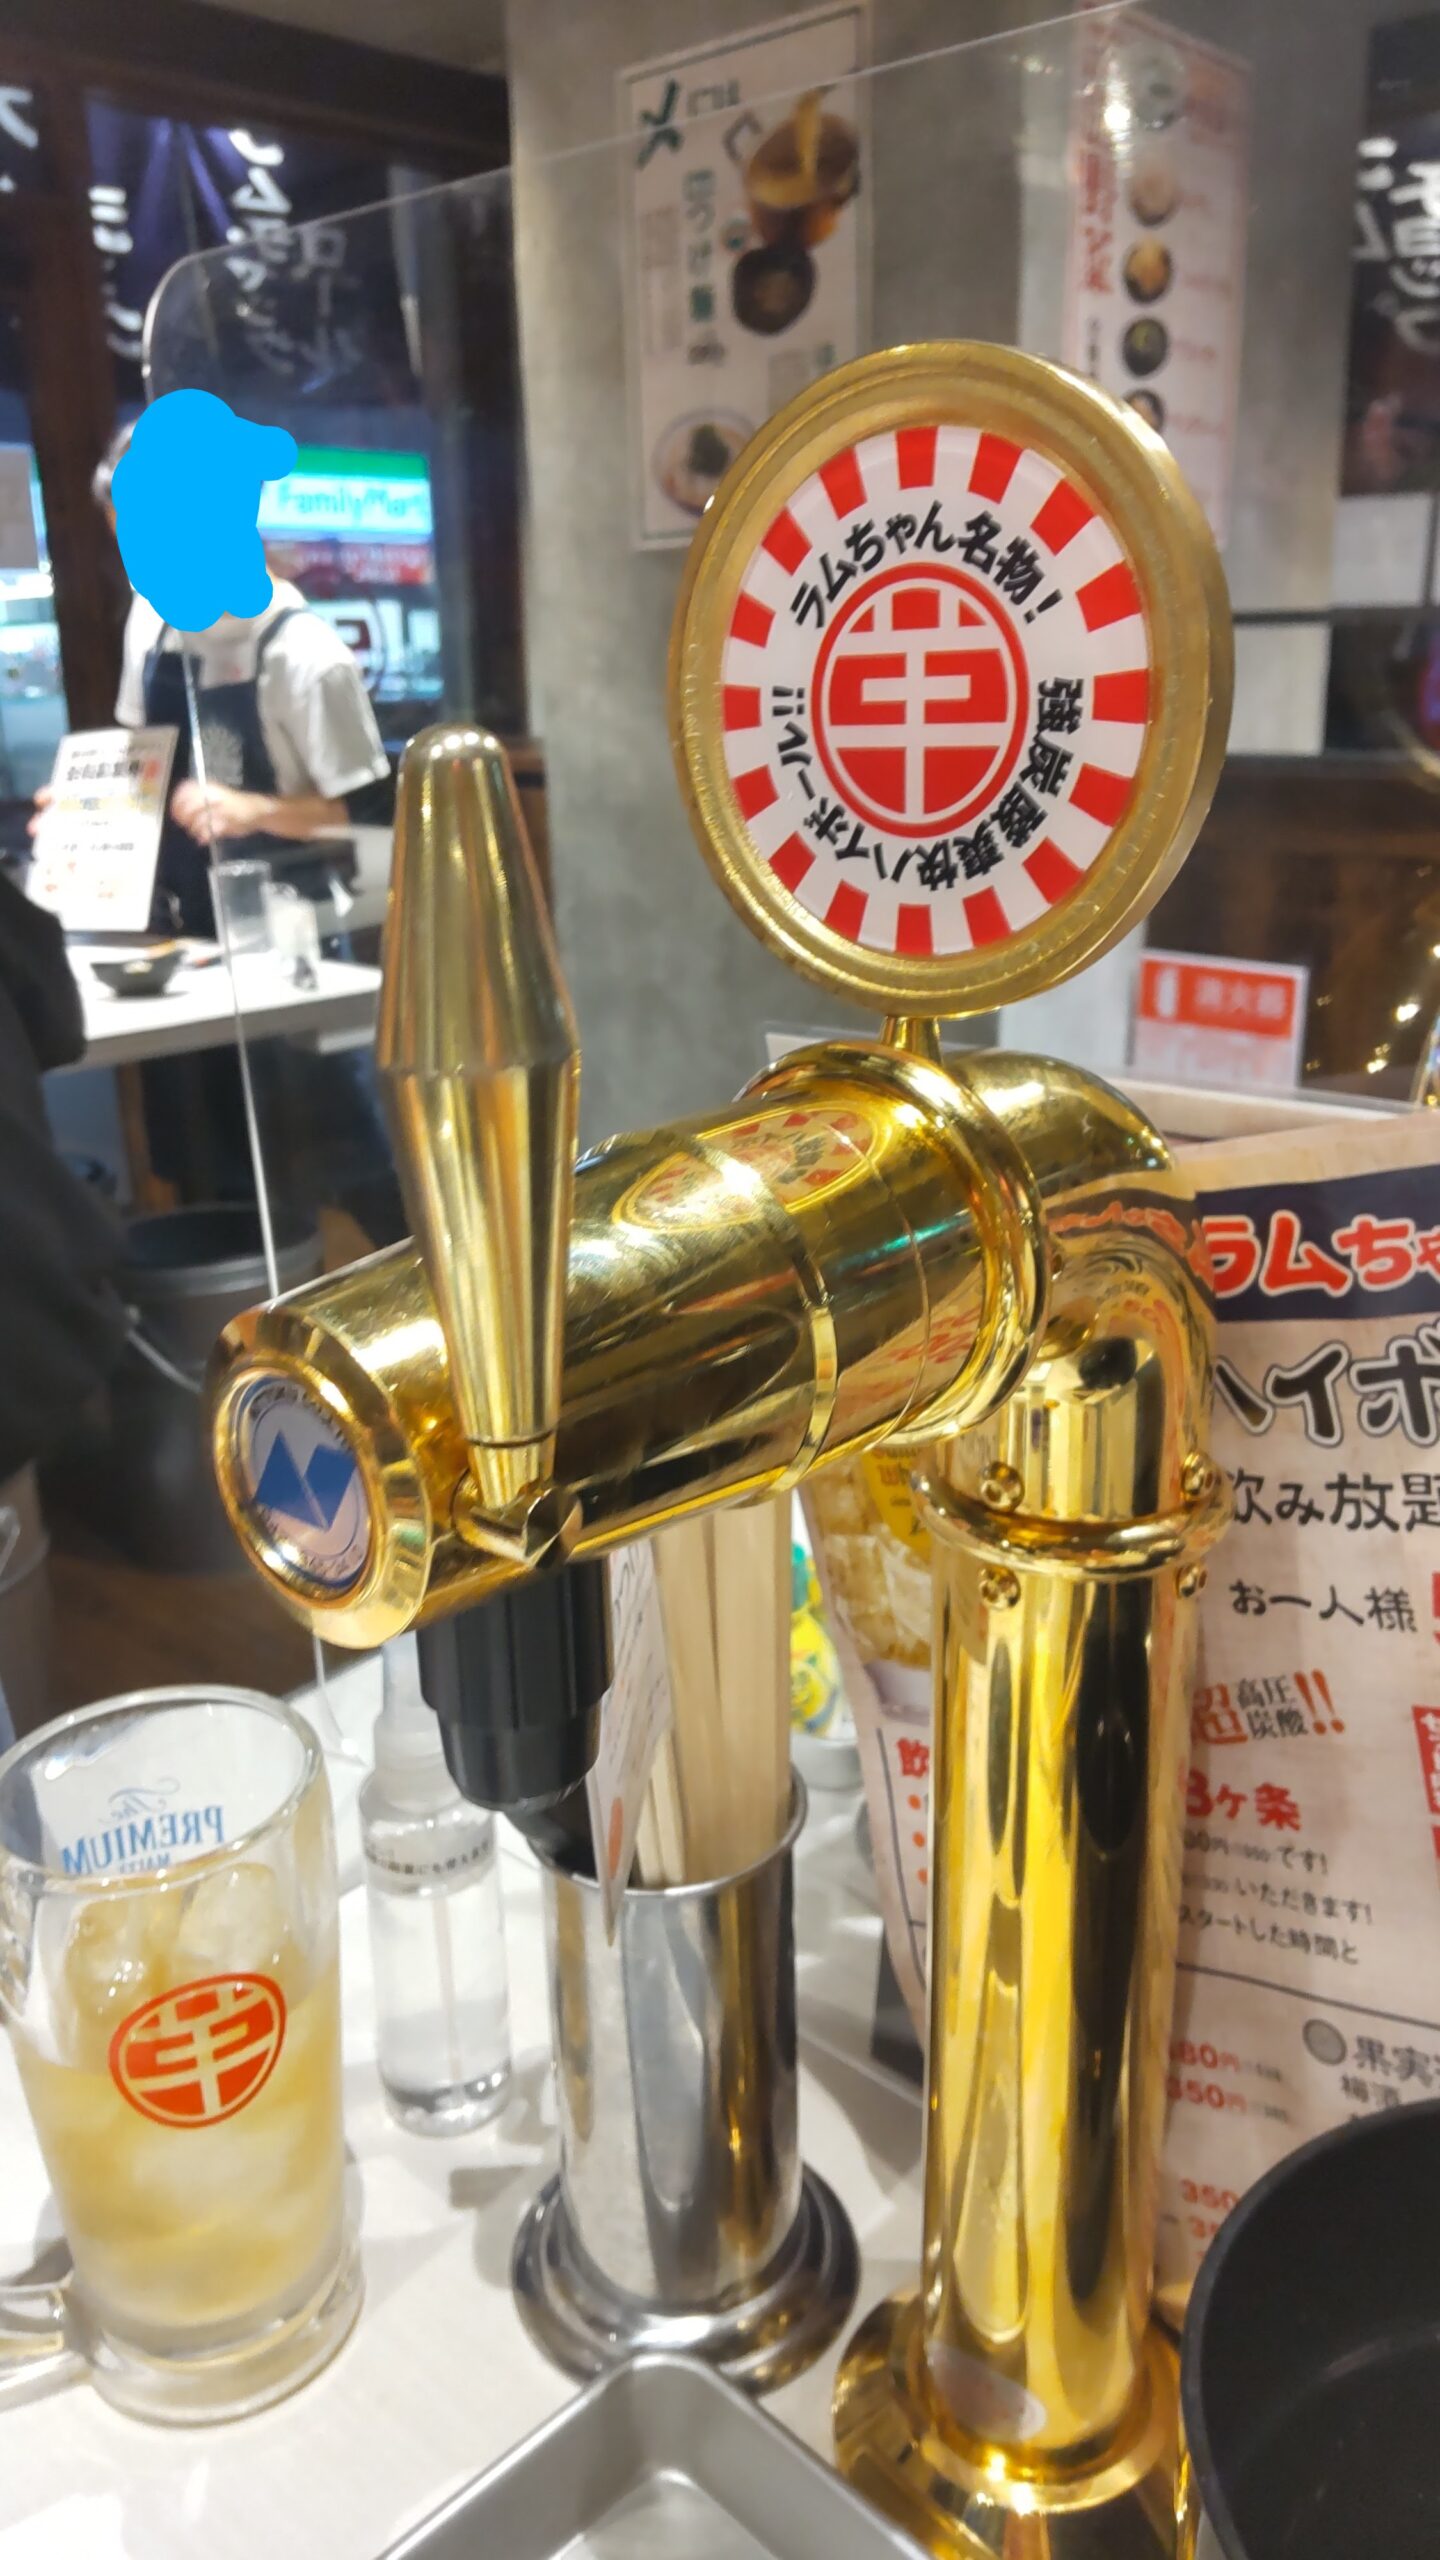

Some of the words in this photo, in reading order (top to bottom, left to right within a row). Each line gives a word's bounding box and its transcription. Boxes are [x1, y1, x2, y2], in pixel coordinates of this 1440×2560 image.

[789, 501, 1063, 628] ラムちゃん名物!
[772, 676, 1085, 891] 強炭酸爽快ハイボール!!
